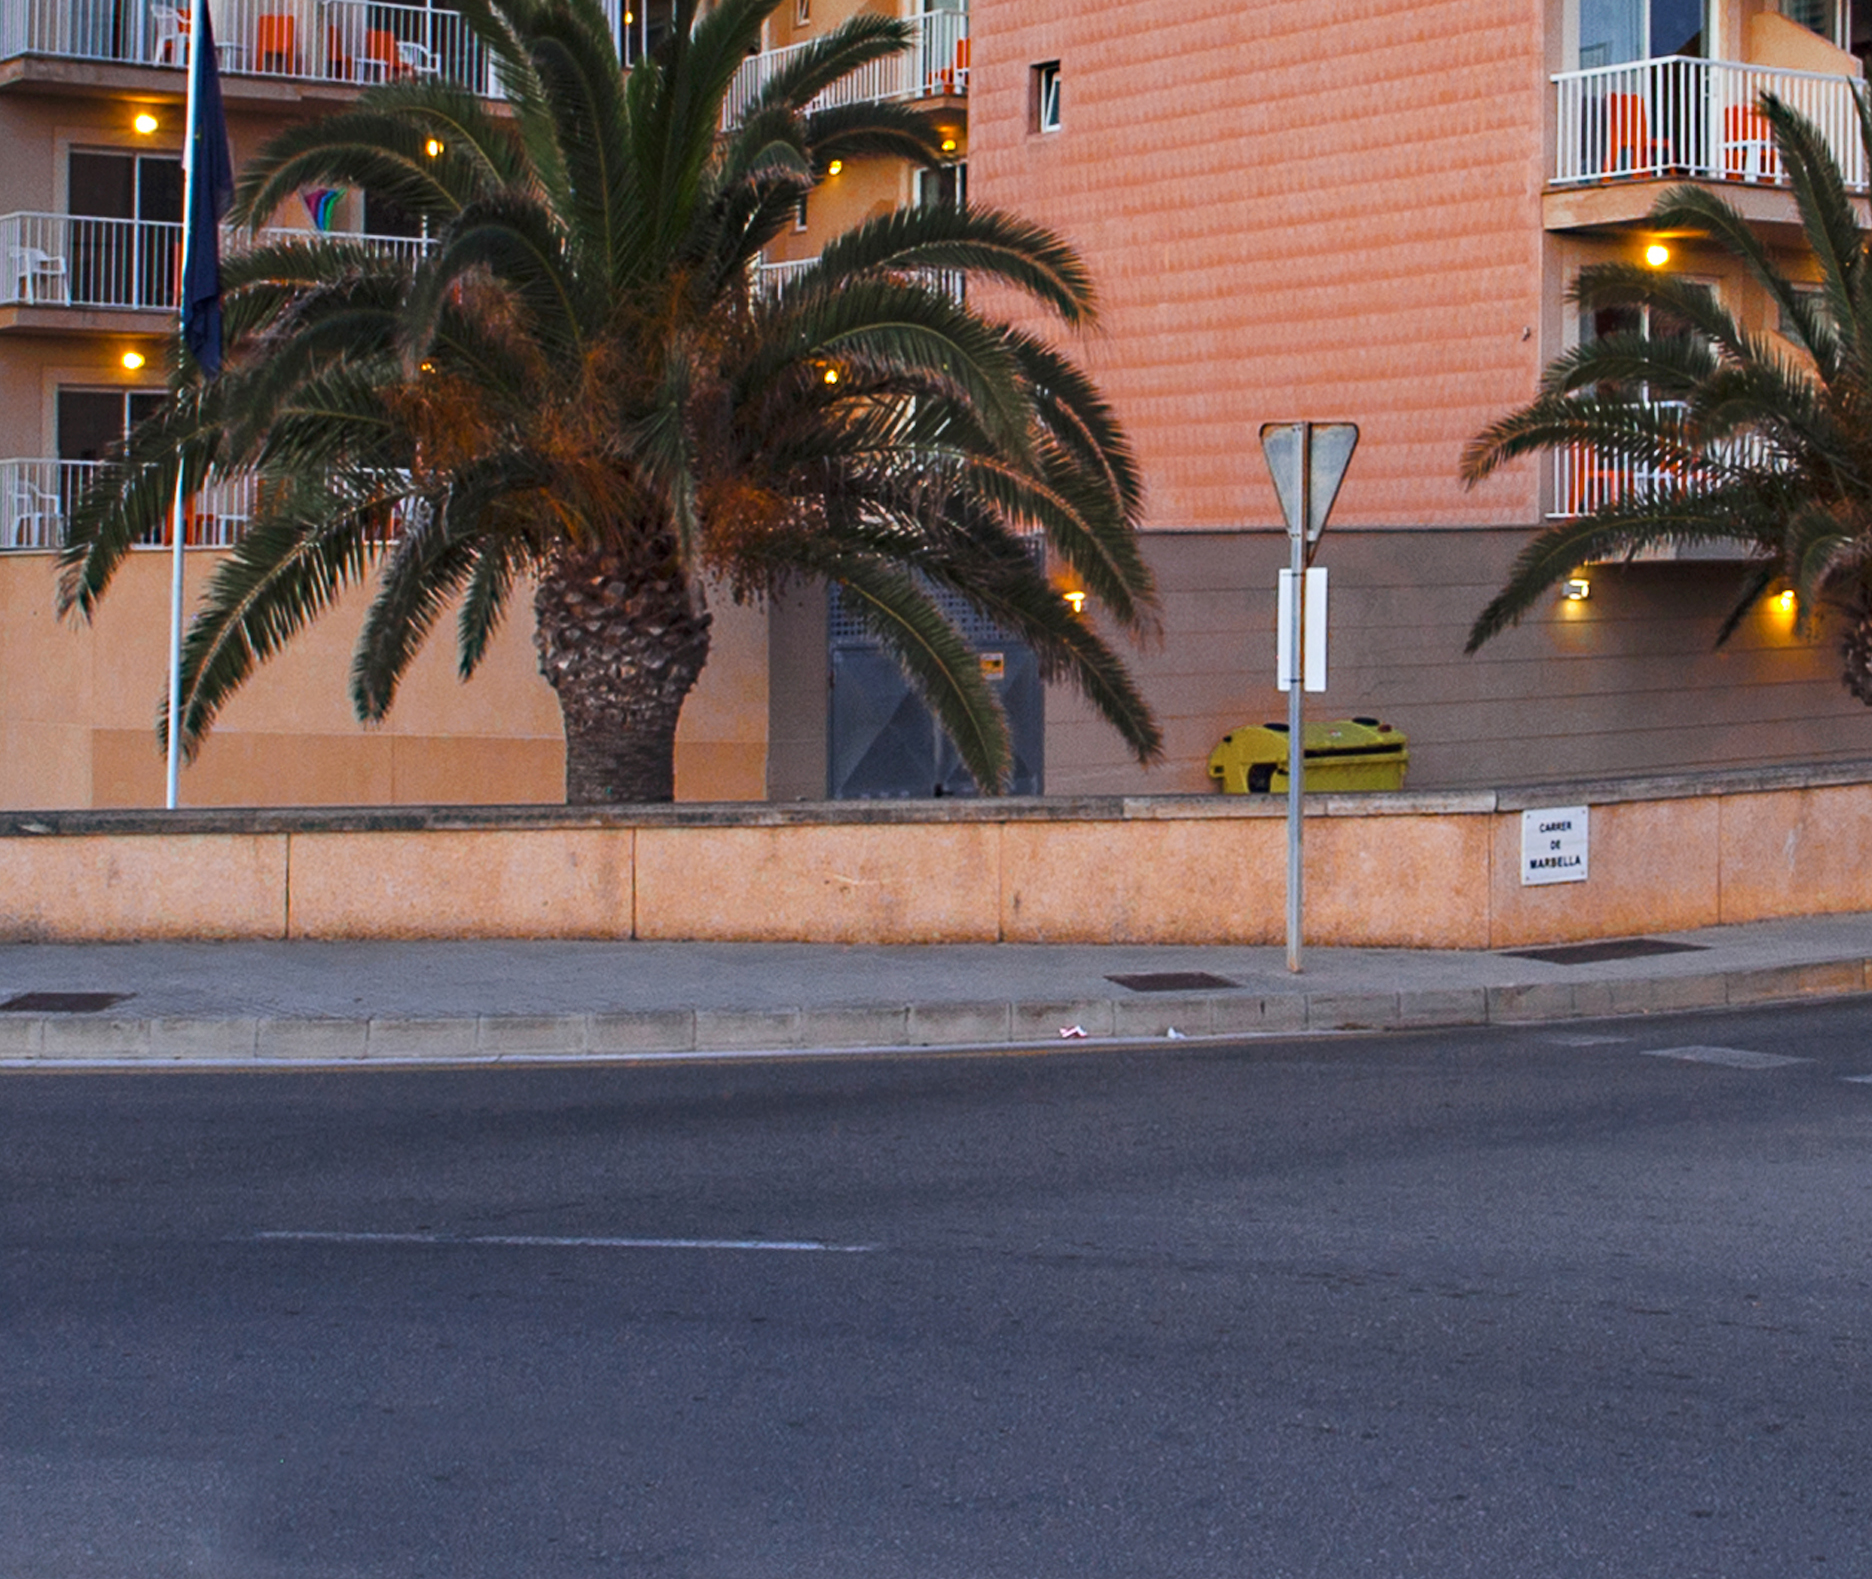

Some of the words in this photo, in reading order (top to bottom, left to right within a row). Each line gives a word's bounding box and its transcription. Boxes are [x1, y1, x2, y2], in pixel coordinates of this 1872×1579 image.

[1539, 820, 1572, 833] CARRER
[1550, 840, 1561, 850] DE
[1529, 855, 1582, 869] MARBELLA
